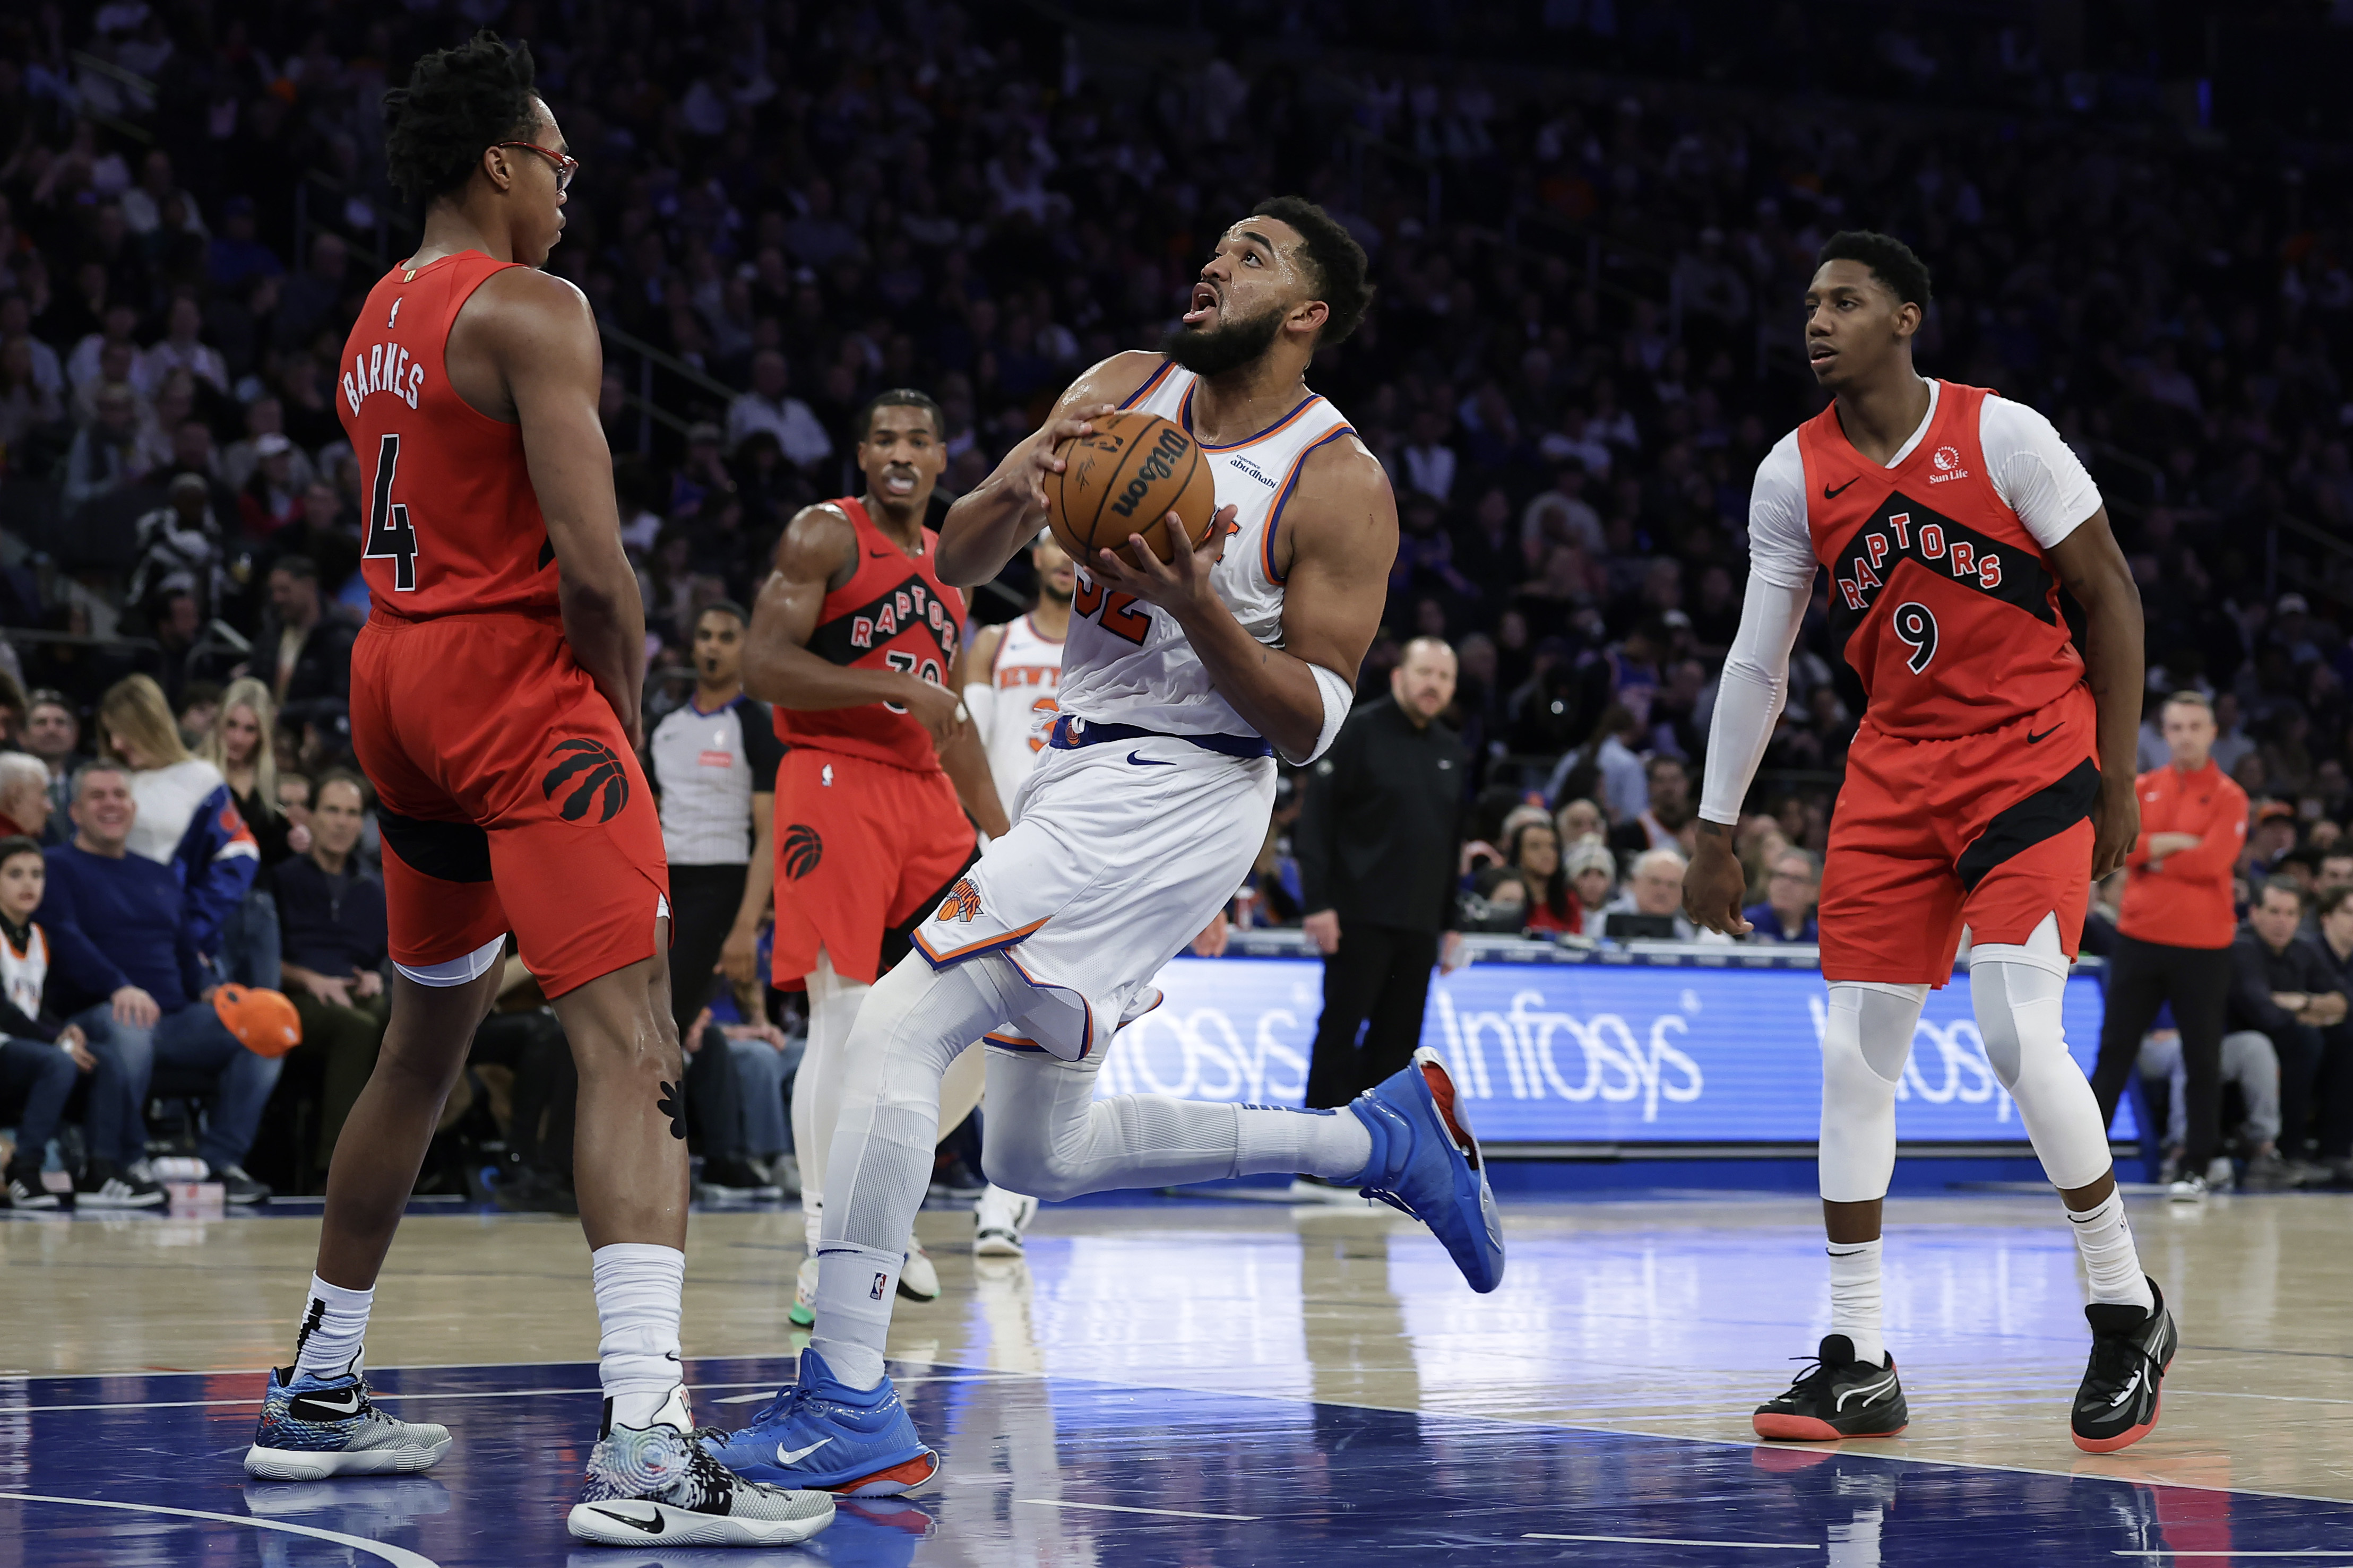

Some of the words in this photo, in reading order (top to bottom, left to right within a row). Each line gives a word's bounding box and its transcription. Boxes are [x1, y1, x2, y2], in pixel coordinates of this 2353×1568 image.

[343, 342, 424, 417] BARNES
[1111, 428, 1190, 517] Wilson
[1230, 460, 1249, 473] abu
[1248, 469, 1278, 489] dhabi
[1236, 454, 1261, 470] experience
[1929, 474, 1949, 484] Sun
[1950, 468, 1968, 480] Life
[363, 434, 418, 592] 4
[1838, 513, 2002, 610] RAPTORS
[851, 585, 958, 671] RAPTOR
[1893, 601, 1939, 675] 9
[1435, 987, 1704, 1122] Infosys
